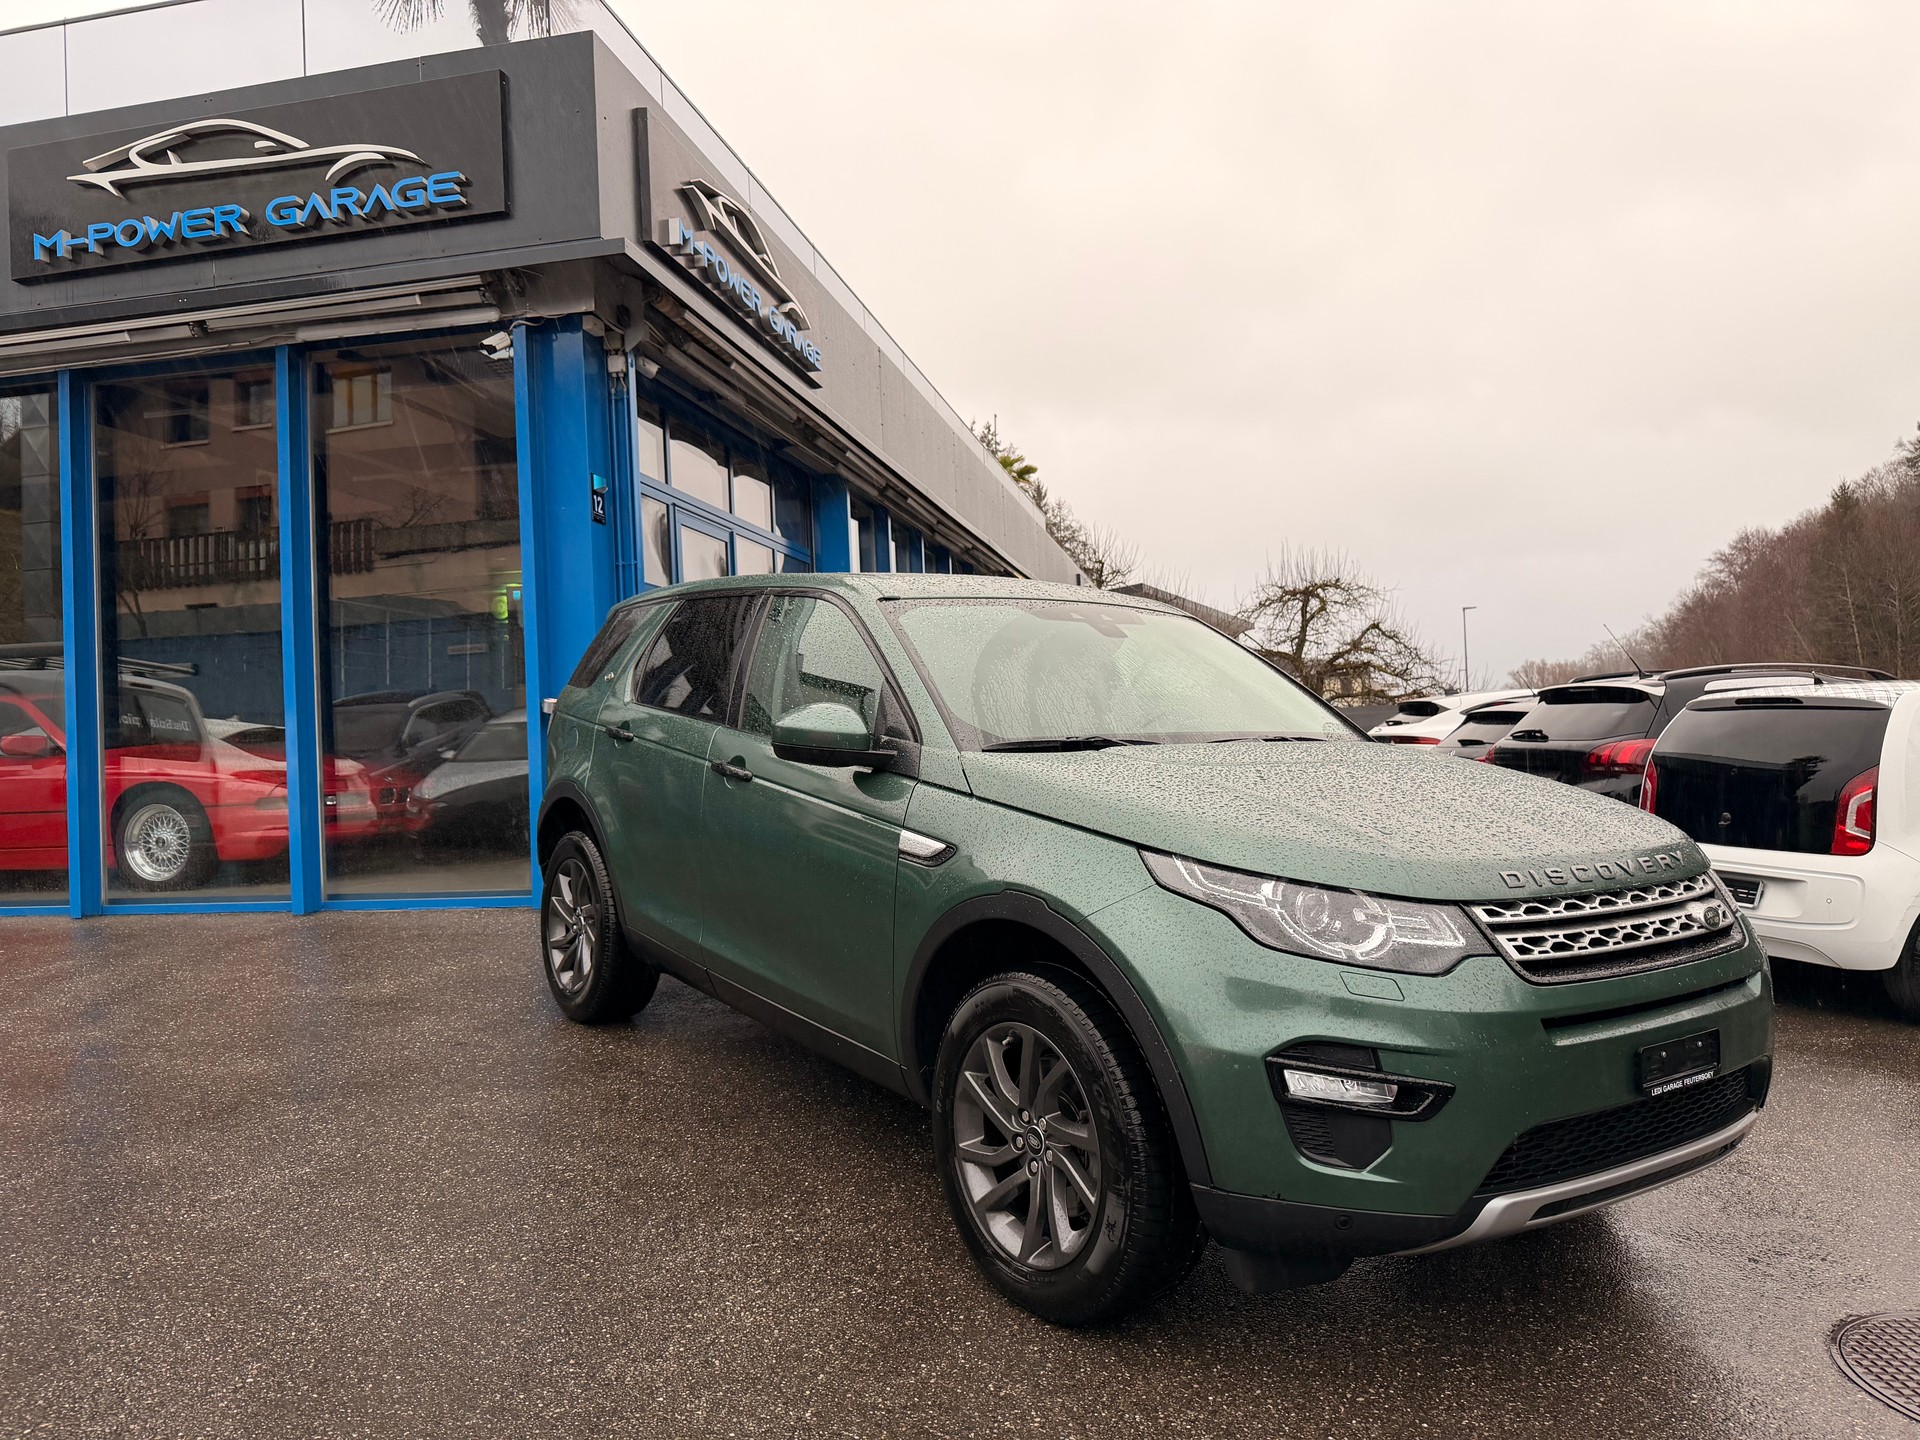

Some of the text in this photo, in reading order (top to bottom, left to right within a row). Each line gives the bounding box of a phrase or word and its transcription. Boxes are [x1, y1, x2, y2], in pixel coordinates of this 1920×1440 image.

[33, 171, 464, 261] M-POWER GARAGE
[768, 305, 823, 370] GARAGE
[593, 495, 604, 514] 12
[1499, 851, 1686, 889] DISCOVERY
[1663, 1080, 1683, 1093] GARAGE
